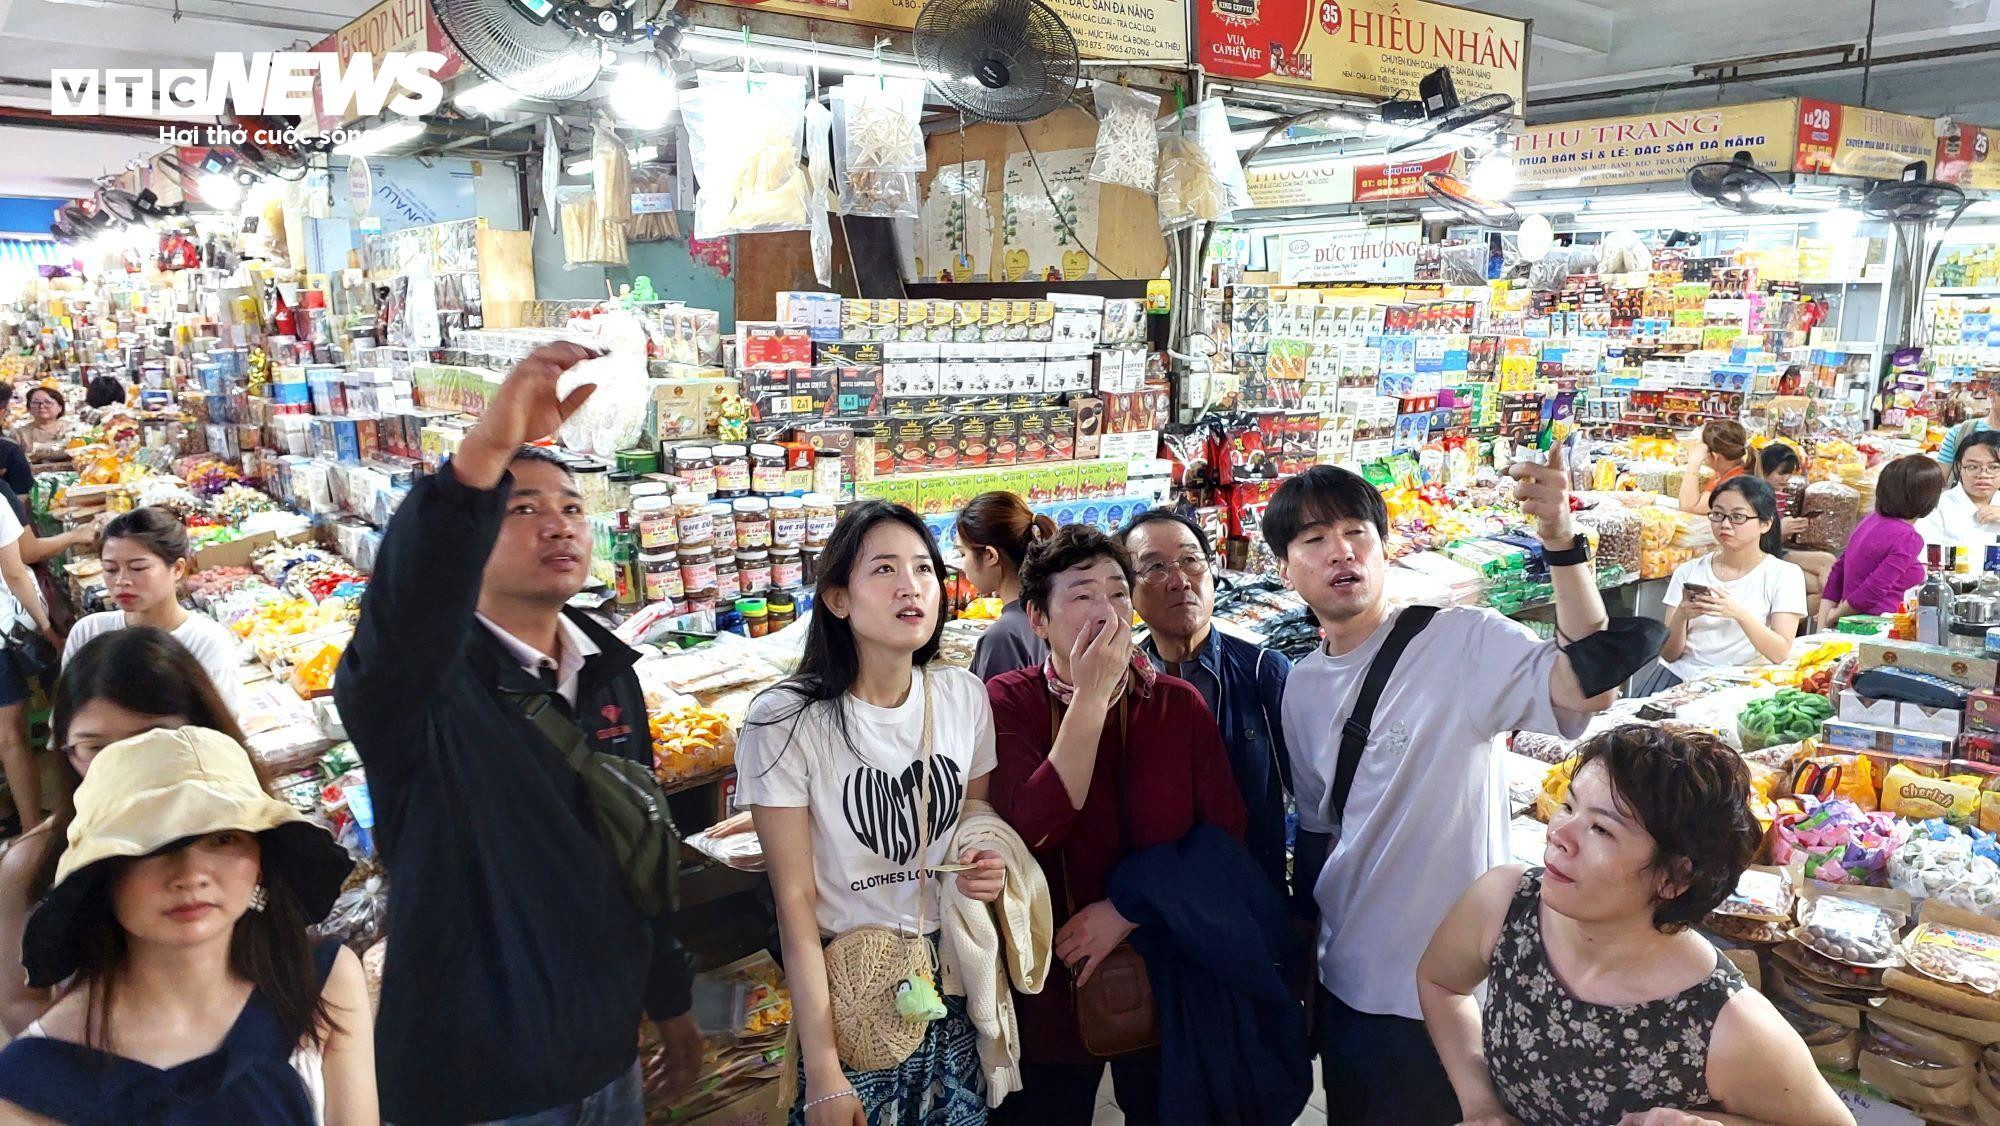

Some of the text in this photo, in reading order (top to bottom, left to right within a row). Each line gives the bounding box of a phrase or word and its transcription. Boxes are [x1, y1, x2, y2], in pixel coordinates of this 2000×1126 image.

[1323, 4, 1338, 24] 35
[1226, 33, 1246, 46] VUA
[1348, 3, 1520, 72] HIẾU NHÂN
[1590, 112, 1721, 143] TRANG
[1814, 109, 1830, 130] 26
[1975, 134, 1988, 154] 25
[1520, 157, 1546, 166] MUA
[1316, 240, 1416, 262] ĐỨC THƯƠNG
[1900, 782, 1955, 809] cherish
[850, 869, 937, 892] CLOTHES LV
